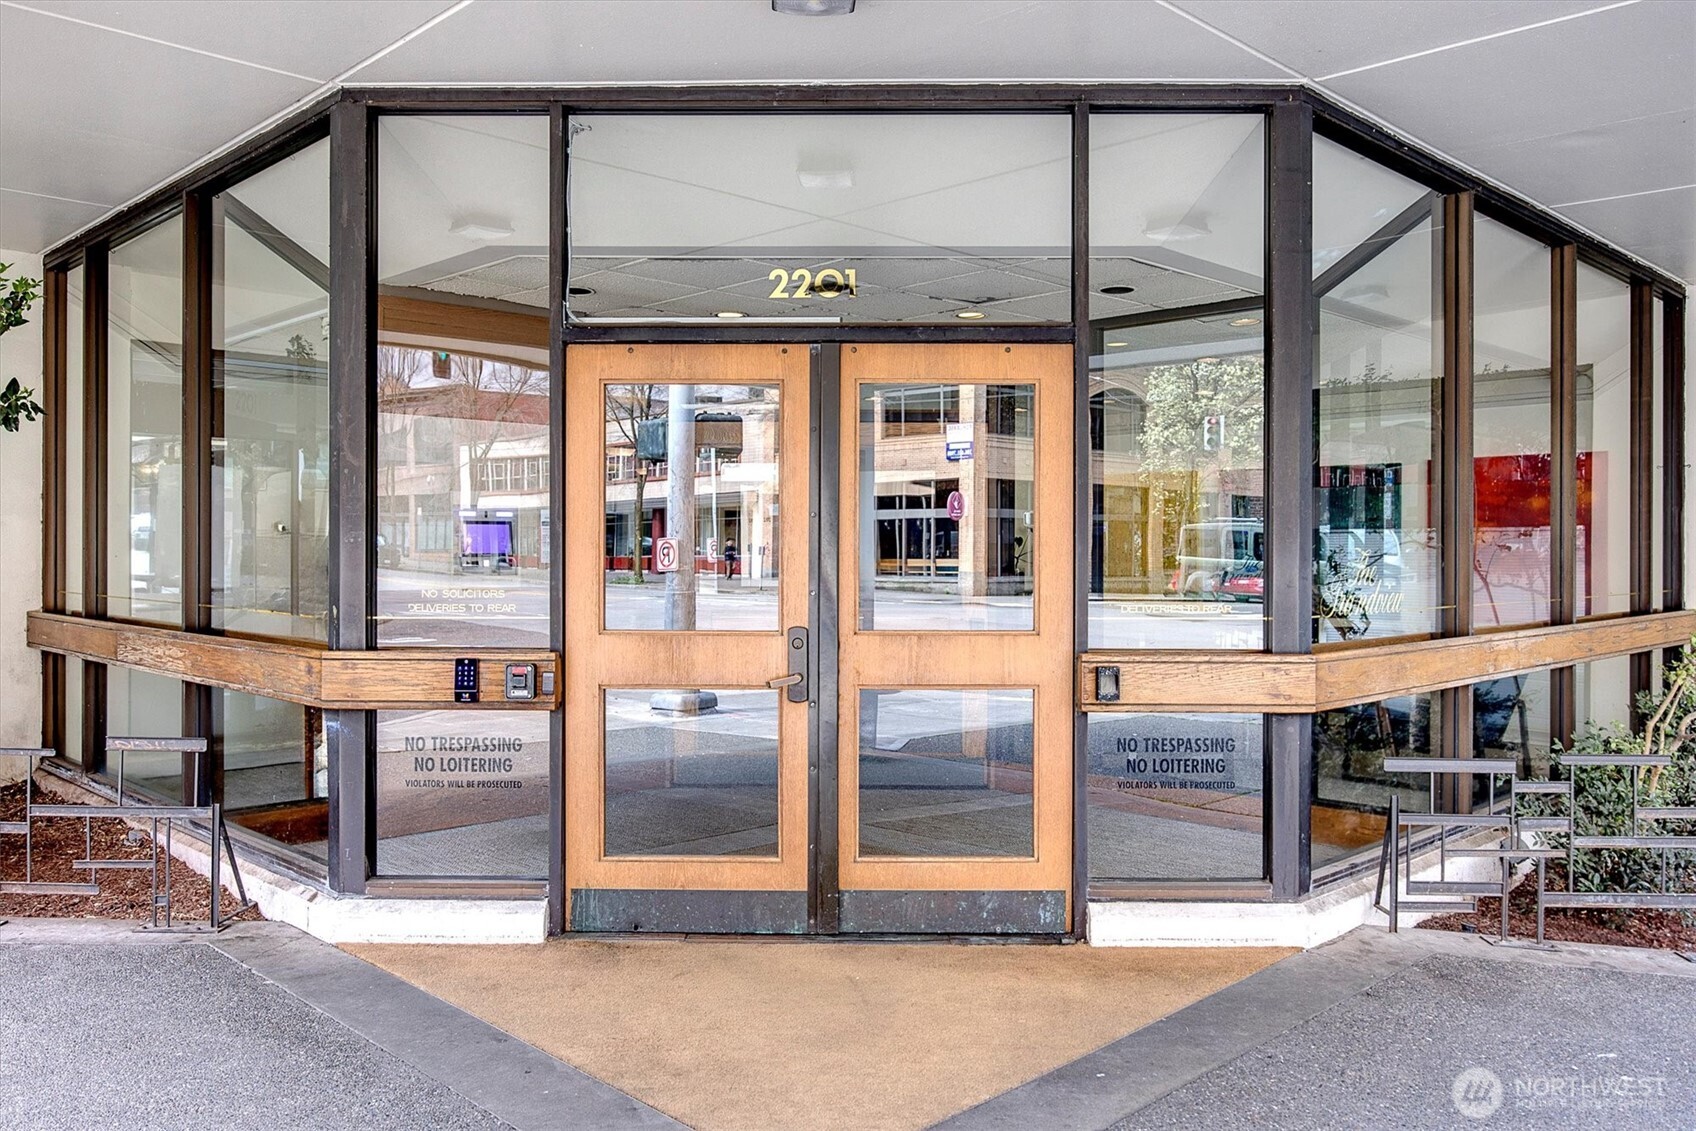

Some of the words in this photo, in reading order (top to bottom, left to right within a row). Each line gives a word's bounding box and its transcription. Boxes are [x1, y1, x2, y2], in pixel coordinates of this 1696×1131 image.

[768, 268, 857, 299] 2201
[421, 589, 439, 599] NO
[442, 589, 506, 599] SOLICITORS
[408, 603, 466, 613] DELIVERIES
[468, 603, 484, 613] TO
[487, 603, 517, 613] REAR
[1203, 604, 1232, 614] REAR
[404, 736, 426, 752] NO
[431, 736, 523, 753] TRESPASSING
[1116, 737, 1138, 753] NO
[1143, 737, 1236, 753] TRESPASSING
[414, 757, 435, 773] NO
[440, 757, 513, 773] LOITERING
[1126, 758, 1148, 774] NO
[1152, 758, 1226, 774] LOITERING
[405, 779, 445, 788] VIOLATORS
[447, 780, 465, 788] WILL
[466, 780, 475, 788] BE
[477, 780, 523, 789] PROSECUTED
[1117, 781, 1157, 789] VIOLATORS
[1159, 781, 1177, 789] WILL
[1179, 781, 1188, 789] BE
[1190, 781, 1236, 790] PROSECUTED
